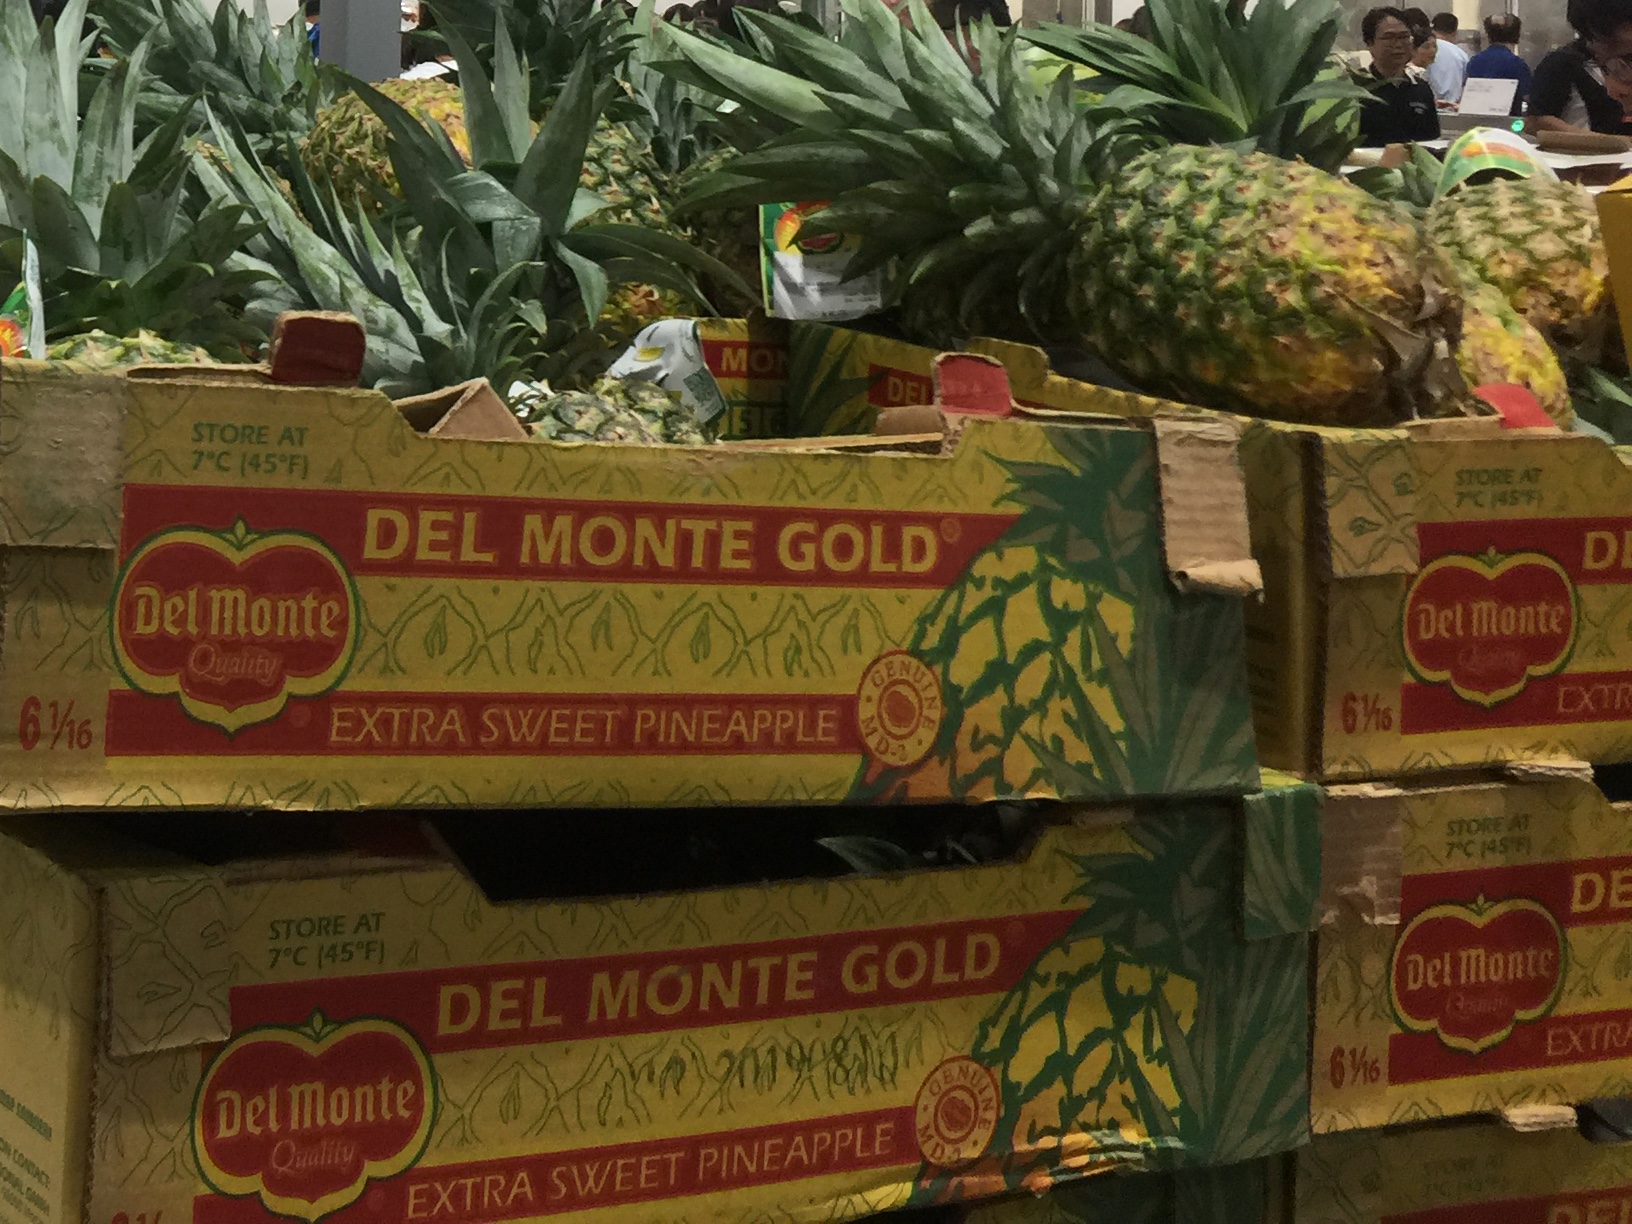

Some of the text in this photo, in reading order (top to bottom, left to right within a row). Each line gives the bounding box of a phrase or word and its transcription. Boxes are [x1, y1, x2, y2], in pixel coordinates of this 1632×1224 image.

[192, 422, 309, 447] STORE AT
[363, 507, 939, 575] DEL MONTE GOLD
[132, 585, 342, 639] Del Monte
[1418, 600, 1565, 640] Del Monte
[188, 644, 281, 686] Quality
[330, 707, 837, 745] EXTRA SWEET PINEAPPLE
[1446, 813, 1532, 838] STORE AT
[269, 911, 386, 941] STORE AT
[436, 932, 1002, 1036] DEL MONTE GOLD
[1406, 947, 1555, 992] Del Monte
[1546, 1021, 1632, 1056] EXTR
[216, 1075, 416, 1140] Del Monte
[272, 1136, 360, 1174] Quality
[407, 1119, 894, 1221] EXTRA SWEET PINEAPPLE
